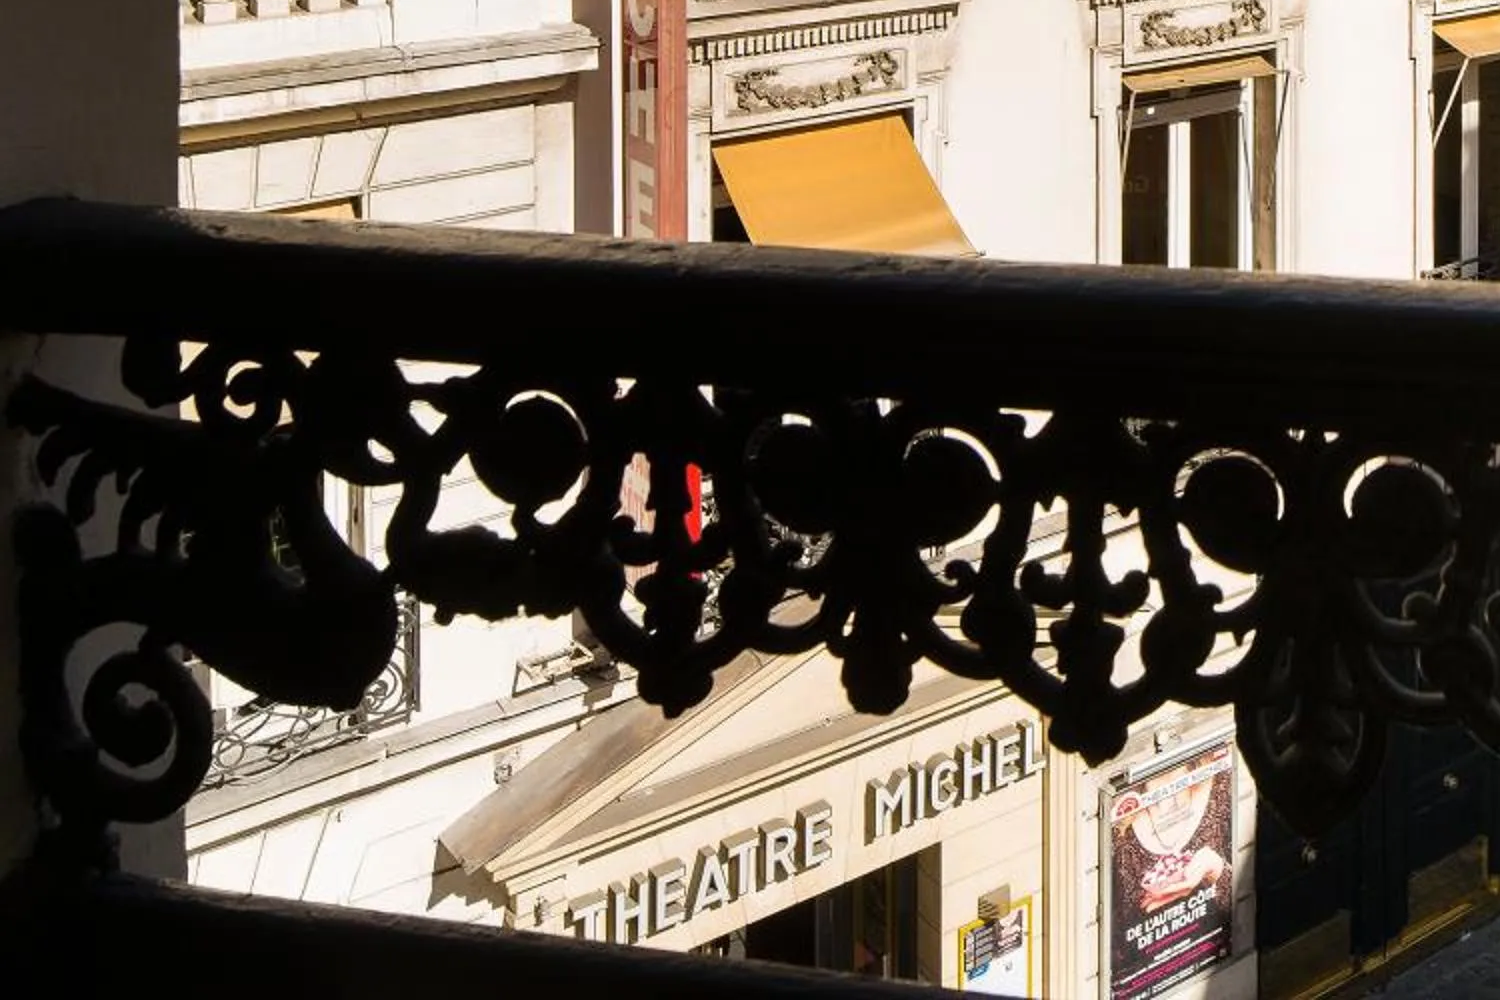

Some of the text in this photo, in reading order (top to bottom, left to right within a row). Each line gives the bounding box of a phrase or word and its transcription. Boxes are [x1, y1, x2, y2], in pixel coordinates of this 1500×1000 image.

[568, 719, 1046, 947] THEATRE MICHEL
[1171, 903, 1208, 931] ROUTE
